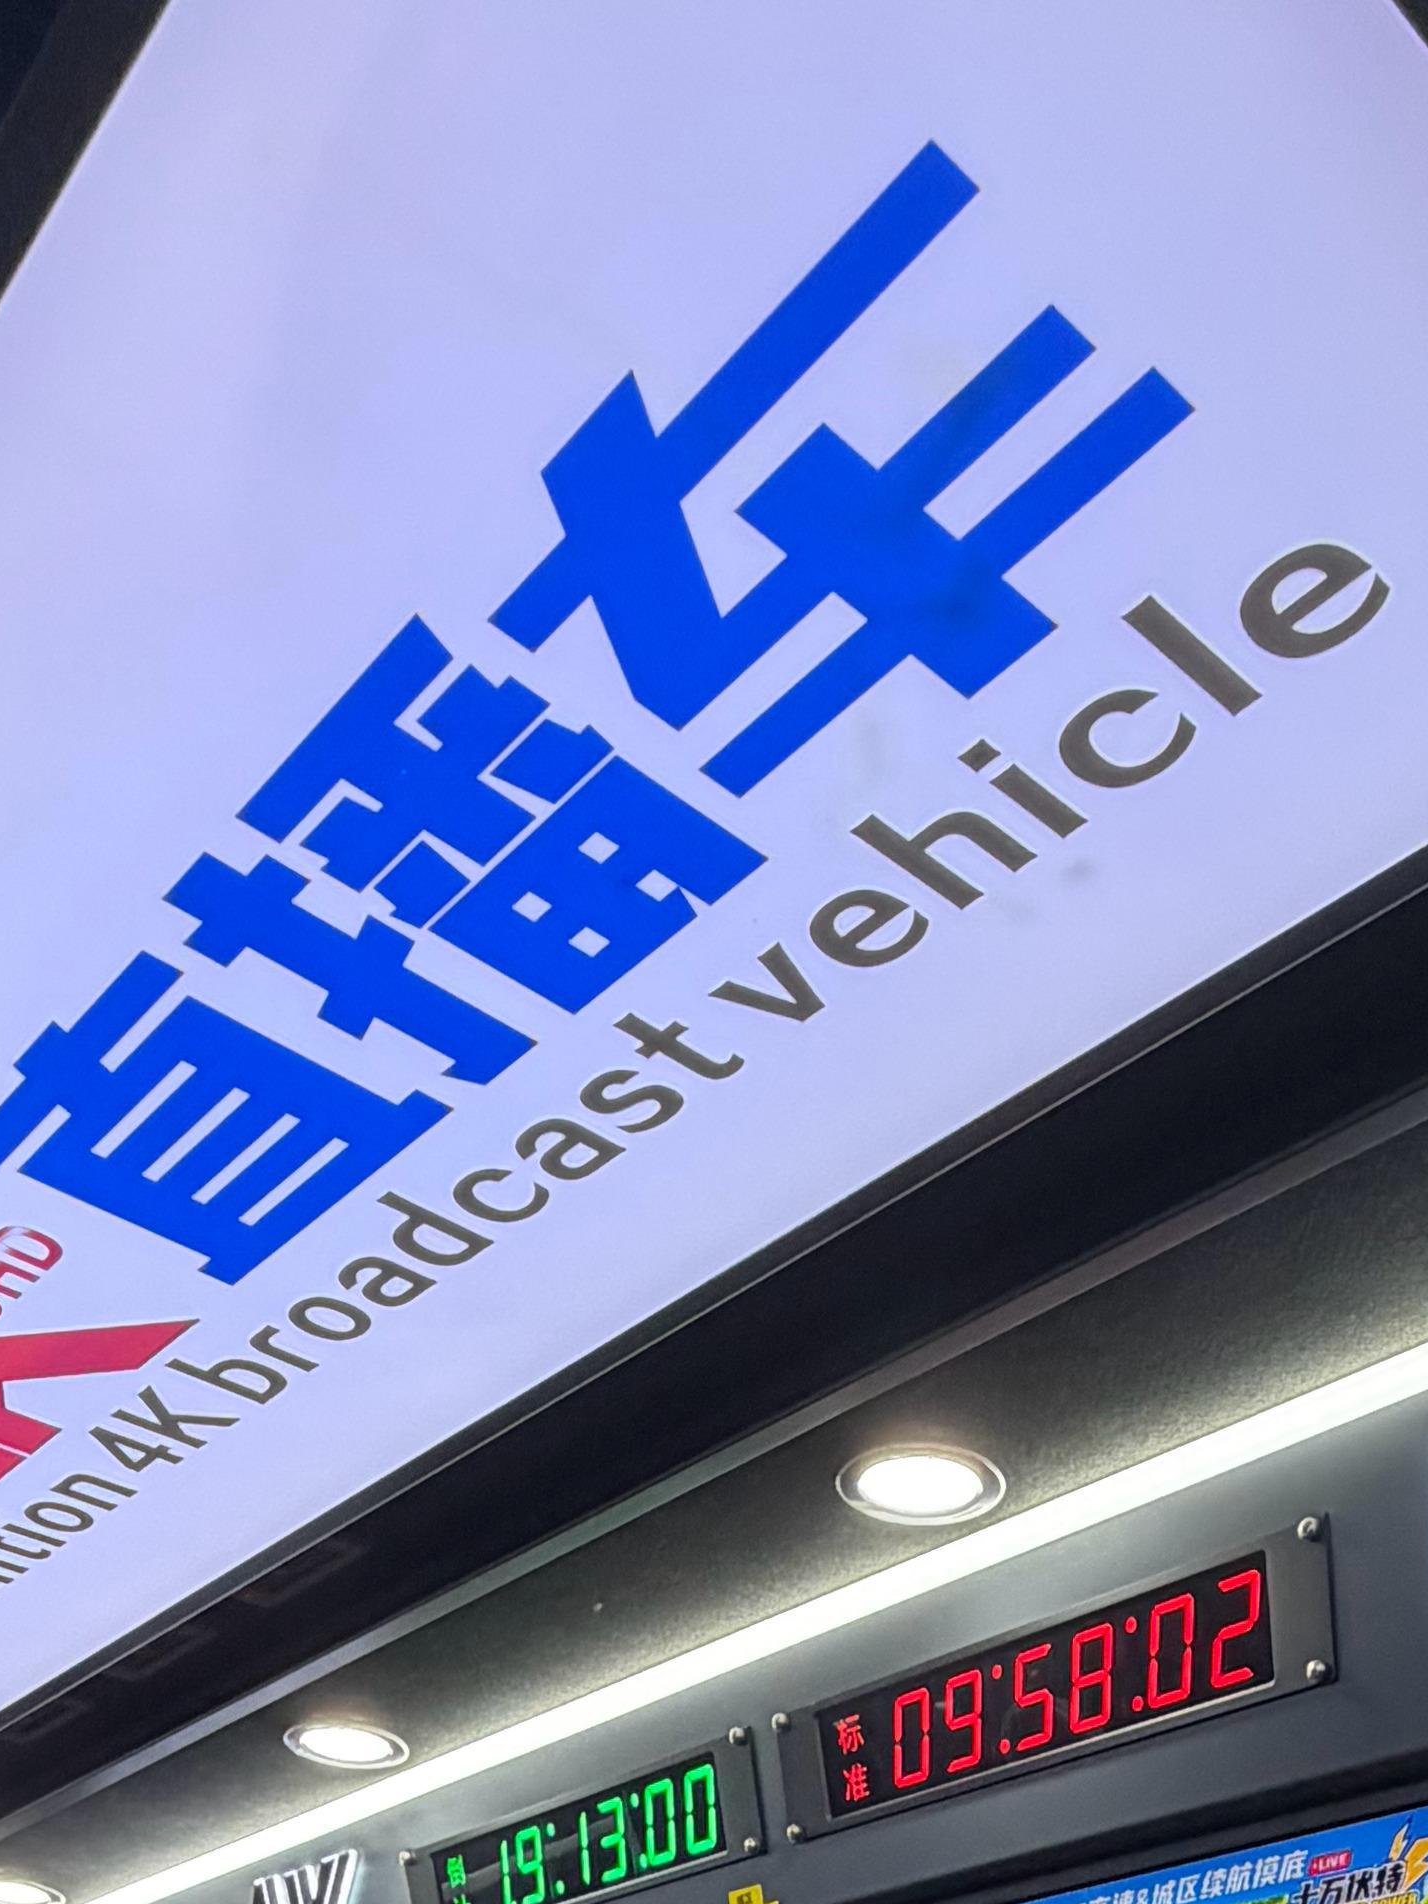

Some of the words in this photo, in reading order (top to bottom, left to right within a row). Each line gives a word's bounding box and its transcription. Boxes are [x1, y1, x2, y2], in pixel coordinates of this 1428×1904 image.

[708, 542, 1392, 1025] vehicle
[164, 1011, 745, 1404] broadcast
[88, 1385, 241, 1473] 4K
[835, 1714, 870, 1803] 标准
[891, 1568, 1264, 1790] 09:58:02
